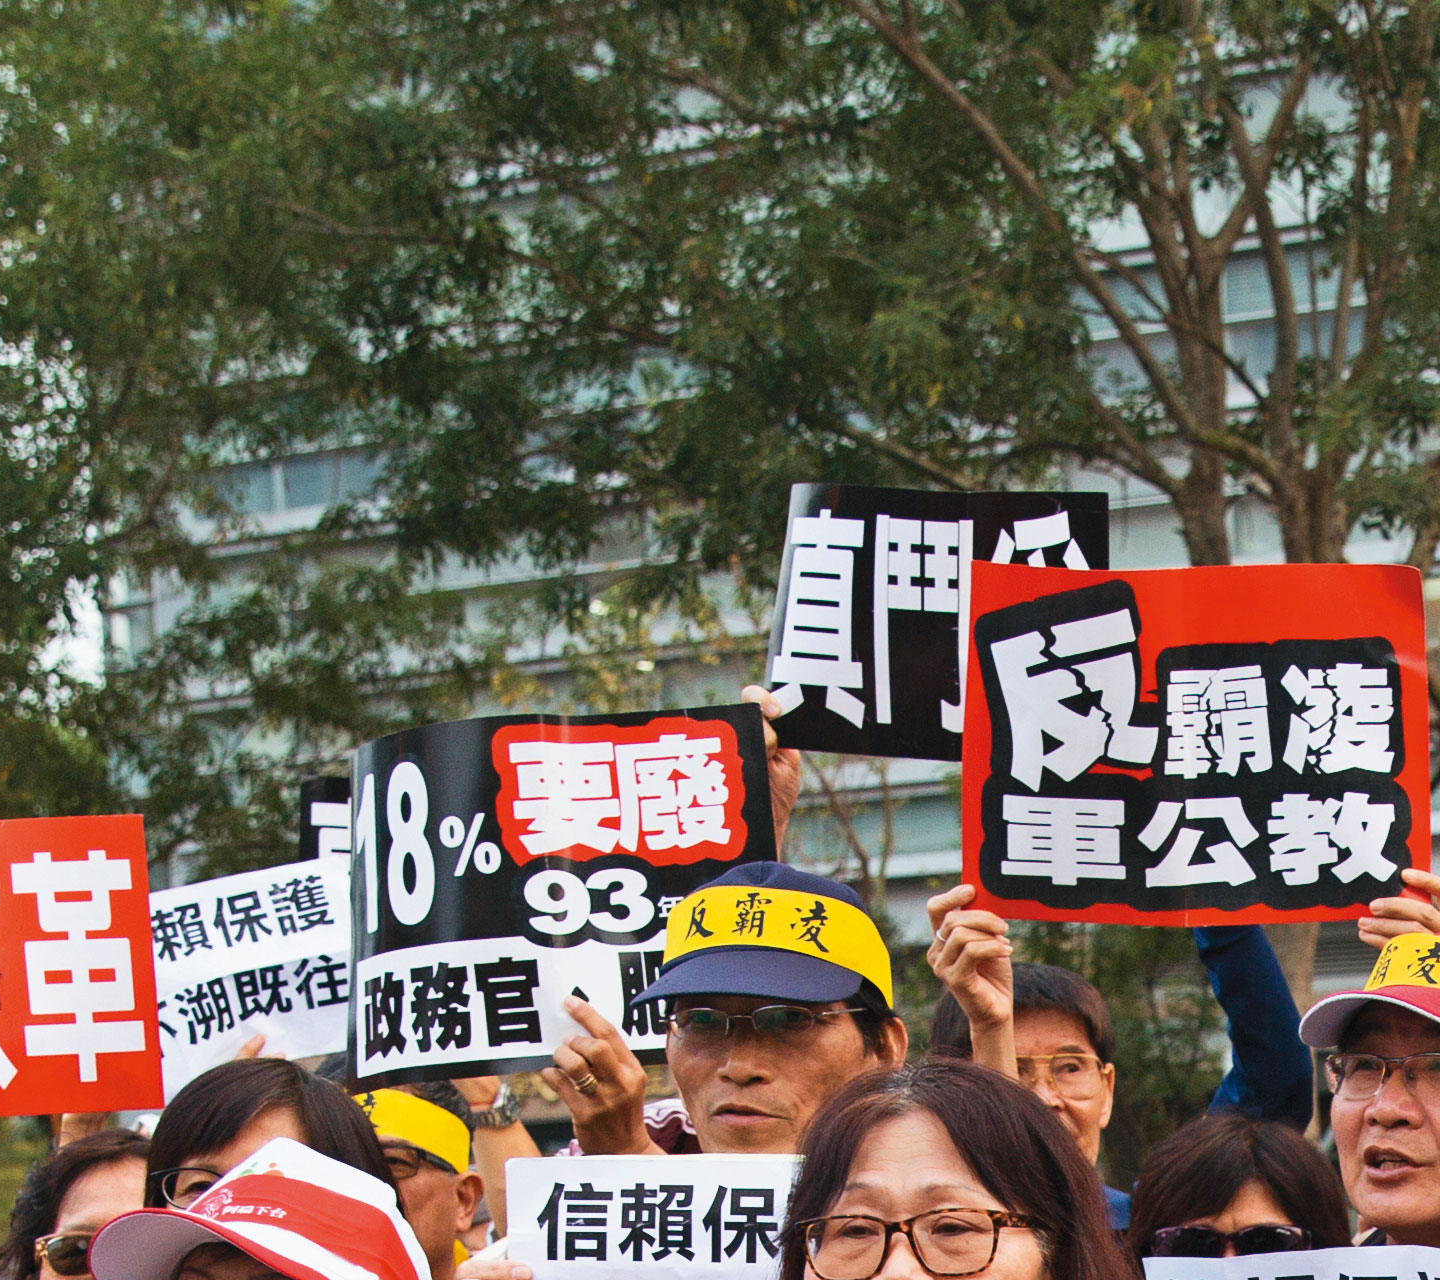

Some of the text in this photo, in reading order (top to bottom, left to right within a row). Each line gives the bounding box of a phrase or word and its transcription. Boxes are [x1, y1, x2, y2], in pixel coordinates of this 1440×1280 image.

[991, 608, 1397, 792] 反霸凌
[509, 734, 732, 855] 要廢
[1001, 792, 1400, 888] 軍公教
[355, 760, 501, 935] 18%
[150, 875, 334, 962] 賴保護
[685, 892, 832, 954] 反霸凌
[536, 1181, 780, 1264] 信賴保
